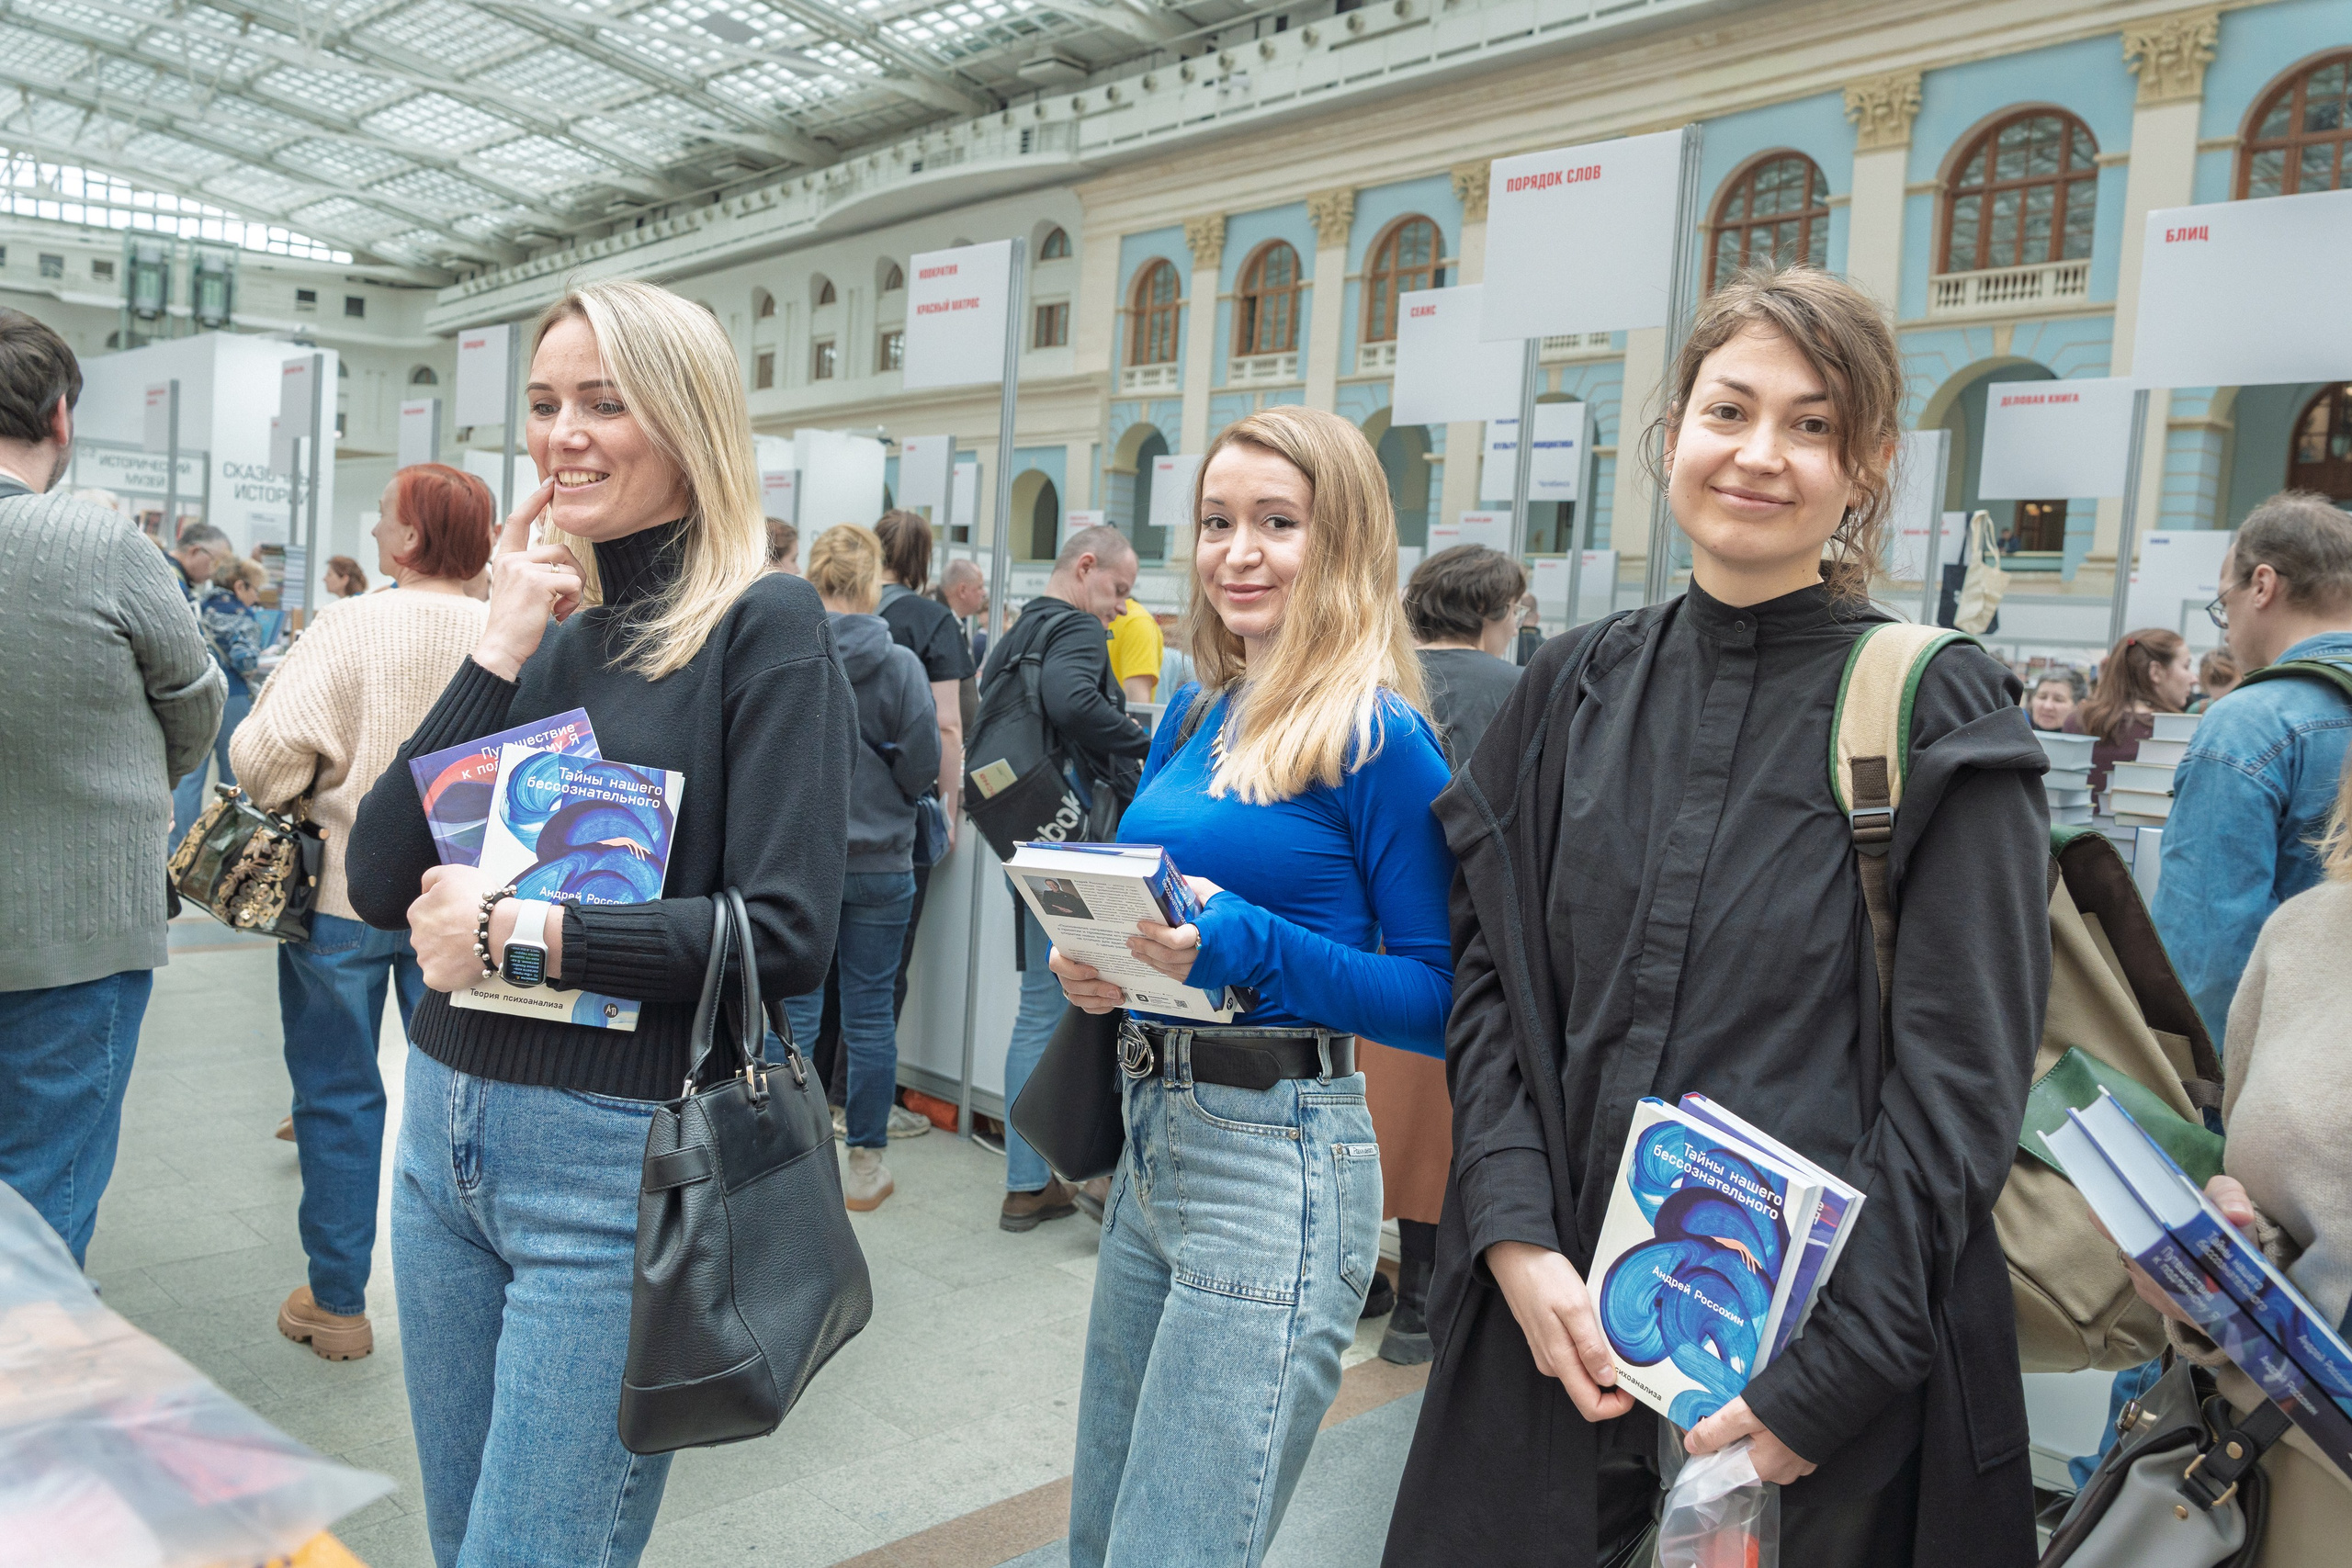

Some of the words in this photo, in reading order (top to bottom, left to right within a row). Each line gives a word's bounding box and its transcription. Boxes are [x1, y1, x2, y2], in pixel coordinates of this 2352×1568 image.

[1506, 170, 1564, 193] ПОРЯДОК
[1566, 164, 1601, 185] СЛОВ
[2165, 224, 2209, 244] БЛИЦ
[916, 298, 949, 315] КРАСНЫЙ
[951, 297, 980, 311] МАТРОС
[1410, 304, 1437, 318] СЕАНС
[2000, 394, 2046, 409] ДЕЛОВАЯ
[2048, 391, 2080, 405] КНИГА
[99, 454, 190, 474] ИСТОРИЧЕСИЙ
[462, 770, 471, 780] к
[569, 732, 581, 747] Я
[526, 776, 661, 809] бессознательного
[559, 766, 604, 786] Тайны
[609, 778, 663, 796] нашего
[469, 987, 500, 1001] Теория
[503, 995, 564, 1010] психоанализа
[1653, 1144, 1780, 1221] бессознательного
[1684, 1142, 1724, 1175] Тайны
[1729, 1170, 1783, 1206] нашего
[2160, 1245, 2215, 1303] Путешествие
[2196, 1238, 2268, 1313] бессознательного
[2206, 1230, 2234, 1260] Тайны
[2232, 1258, 2265, 1292] нашего
[1651, 1265, 1691, 1295] Андрей
[1693, 1289, 1746, 1327] Россохин
[2152, 1255, 2163, 1265] к
[2159, 1262, 2210, 1313] подлинному
[2208, 1311, 2222, 1322] Я
[1614, 1365, 1662, 1402] сихоанализа
